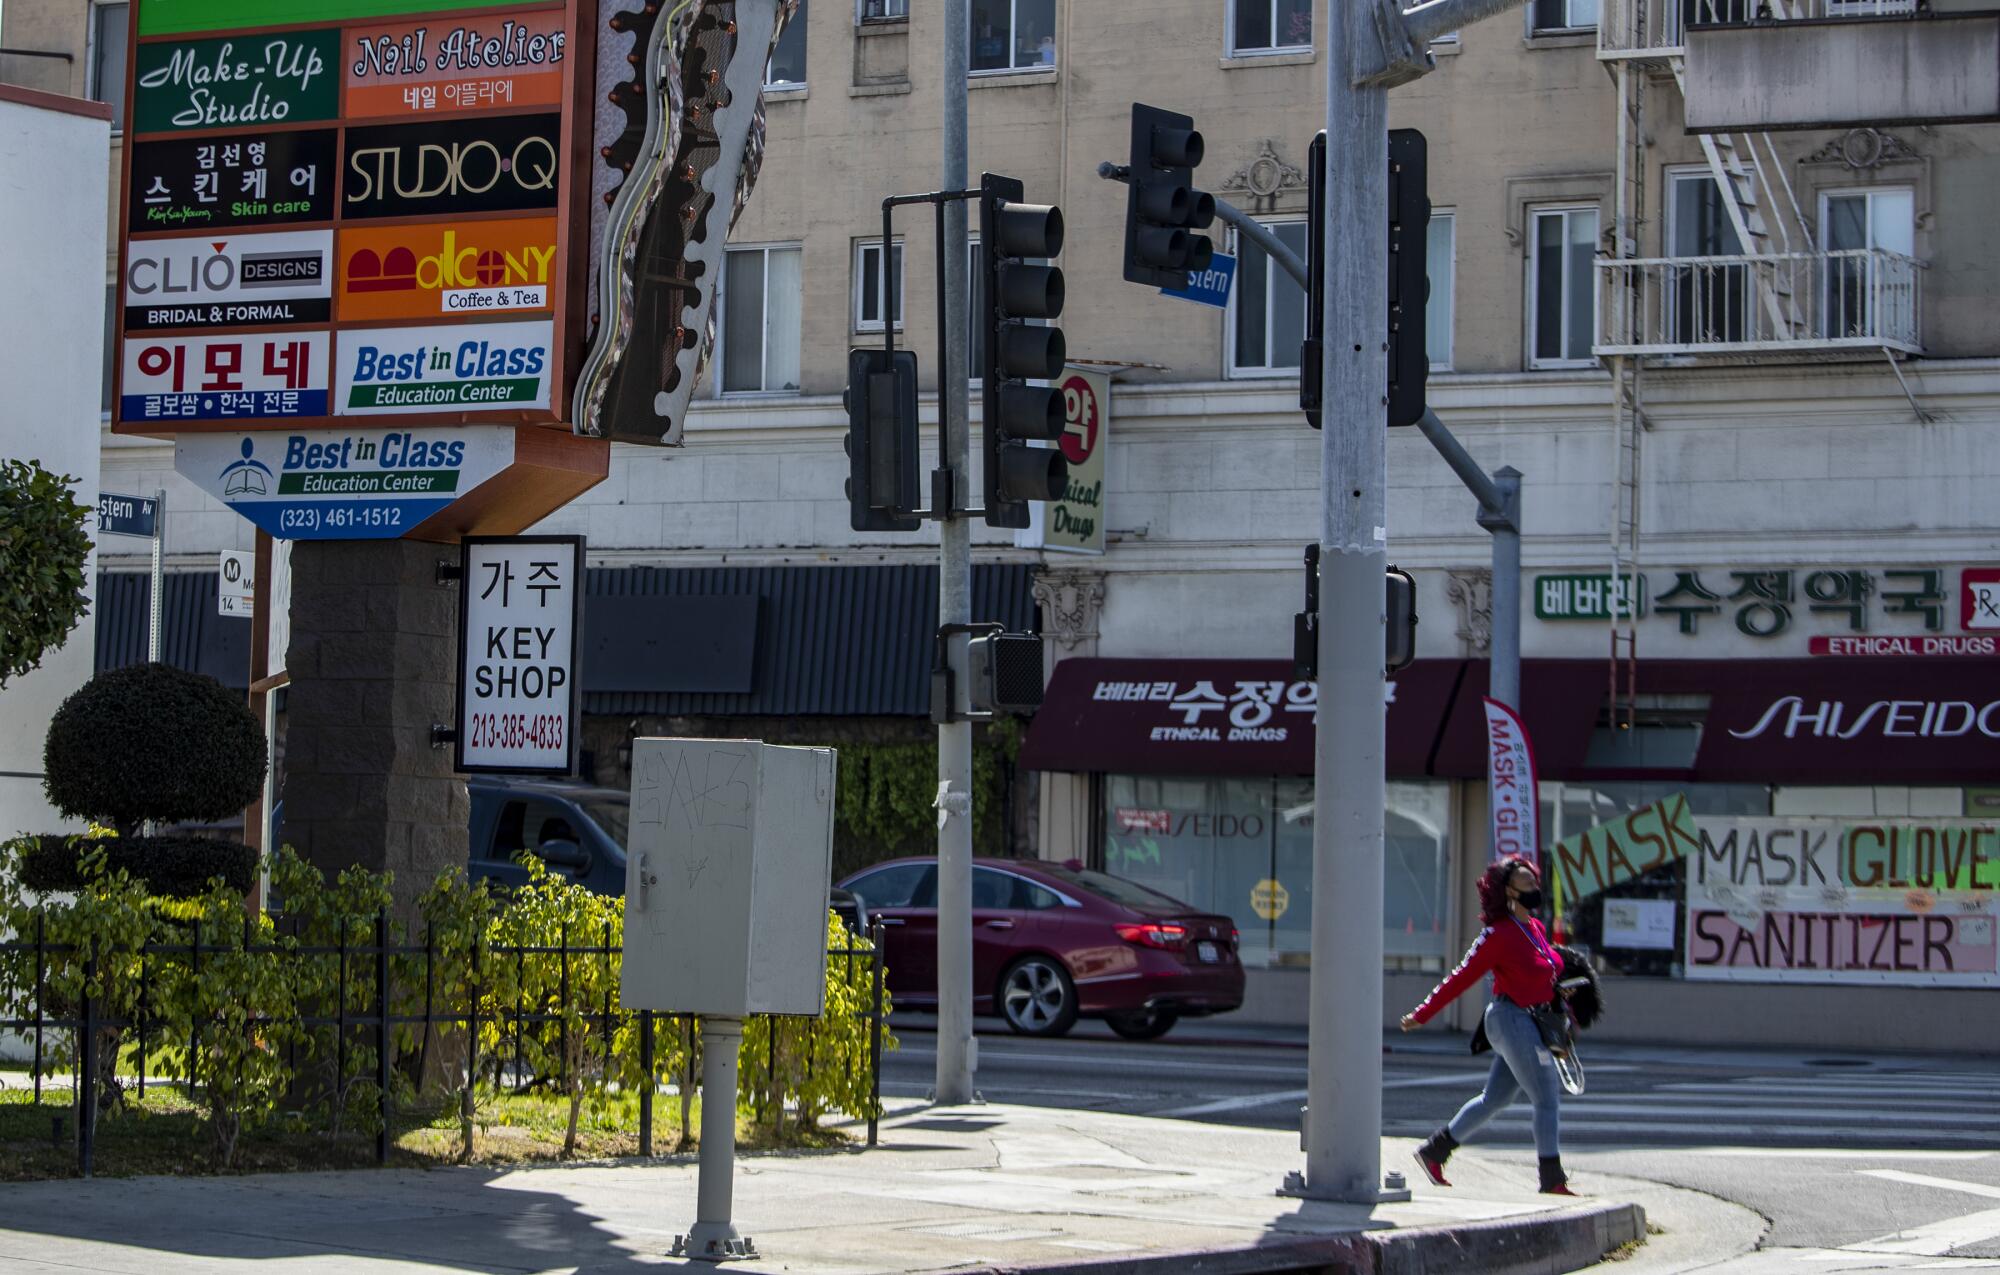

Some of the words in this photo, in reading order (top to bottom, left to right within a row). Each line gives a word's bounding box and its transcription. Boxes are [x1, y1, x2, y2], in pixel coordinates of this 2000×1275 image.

[139, 40, 323, 91] Make-Up
[354, 28, 427, 76] Nail
[437, 21, 565, 69] Atelier
[172, 82, 289, 126] Studio
[403, 86, 436, 110] 네일
[444, 79, 513, 106] 아뜰리에
[197, 141, 266, 169] 김선영
[144, 165, 316, 203] 스킨케어
[231, 202, 267, 217] Skin
[272, 201, 311, 214] care
[128, 254, 235, 295] CLIO
[244, 261, 318, 279] DESIGNS
[1187, 269, 1228, 293] stern
[148, 309, 206, 324] BRIDAL
[209, 306, 223, 323] &
[226, 305, 294, 321] FORMAL
[448, 292, 493, 308] Coffee
[497, 291, 510, 306] &
[514, 290, 540, 304] Tea
[137, 341, 311, 393] 이모네
[353, 347, 426, 382] Best
[429, 346, 451, 370] in
[455, 341, 546, 378] Class
[219, 392, 256, 415] 한식
[263, 391, 299, 413] 전문
[375, 386, 455, 405] Education
[460, 383, 514, 401] Center
[283, 435, 351, 470] Best
[355, 437, 376, 461] in
[379, 432, 466, 469] Class
[303, 475, 378, 492] Education
[382, 474, 435, 491] Center
[97, 496, 133, 519] stern
[280, 508, 320, 531] (323)
[325, 508, 400, 527] 461-1512
[1053, 504, 1094, 543] Drugs
[481, 560, 561, 607] 가주
[222, 596, 233, 611] 14
[1653, 569, 1946, 637] 수정약국
[487, 627, 555, 659] KEY
[1828, 637, 1918, 655] ETHICAL
[1922, 637, 1996, 655] DRUGS
[475, 666, 566, 698] SHOP
[471, 713, 563, 750] 213-385-4833
[1150, 727, 1221, 741] ETHICAL
[1227, 727, 1288, 741] DRUGS
[1490, 719, 1517, 790] MASK
[1496, 808, 1519, 856] GLO
[1556, 791, 1701, 901] MASK
[1698, 827, 1827, 886] MASK
[1848, 825, 2000, 890] GLOVE
[1694, 911, 1954, 972] SANITIZER
